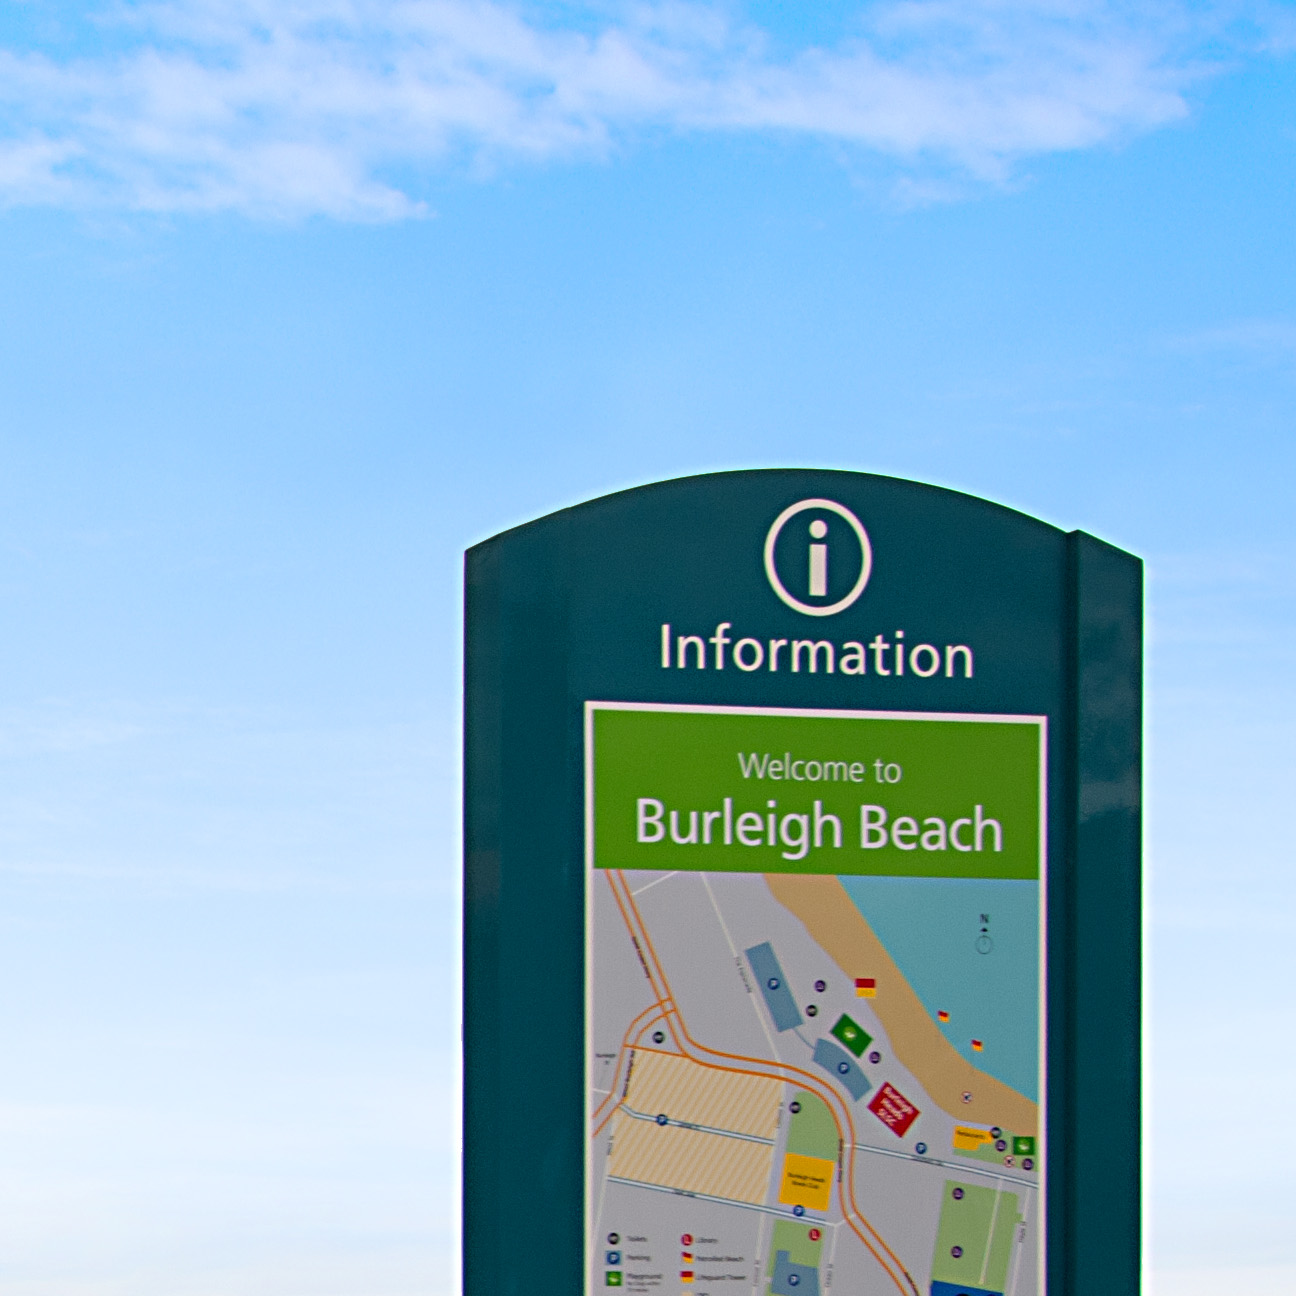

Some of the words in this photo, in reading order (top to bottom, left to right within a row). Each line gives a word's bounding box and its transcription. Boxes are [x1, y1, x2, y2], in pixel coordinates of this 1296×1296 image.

[660, 623, 975, 679] Information
[737, 752, 865, 783] Welcome
[873, 758, 902, 784] to
[634, 797, 843, 860] Burleigh
[859, 804, 1004, 852] Beach
